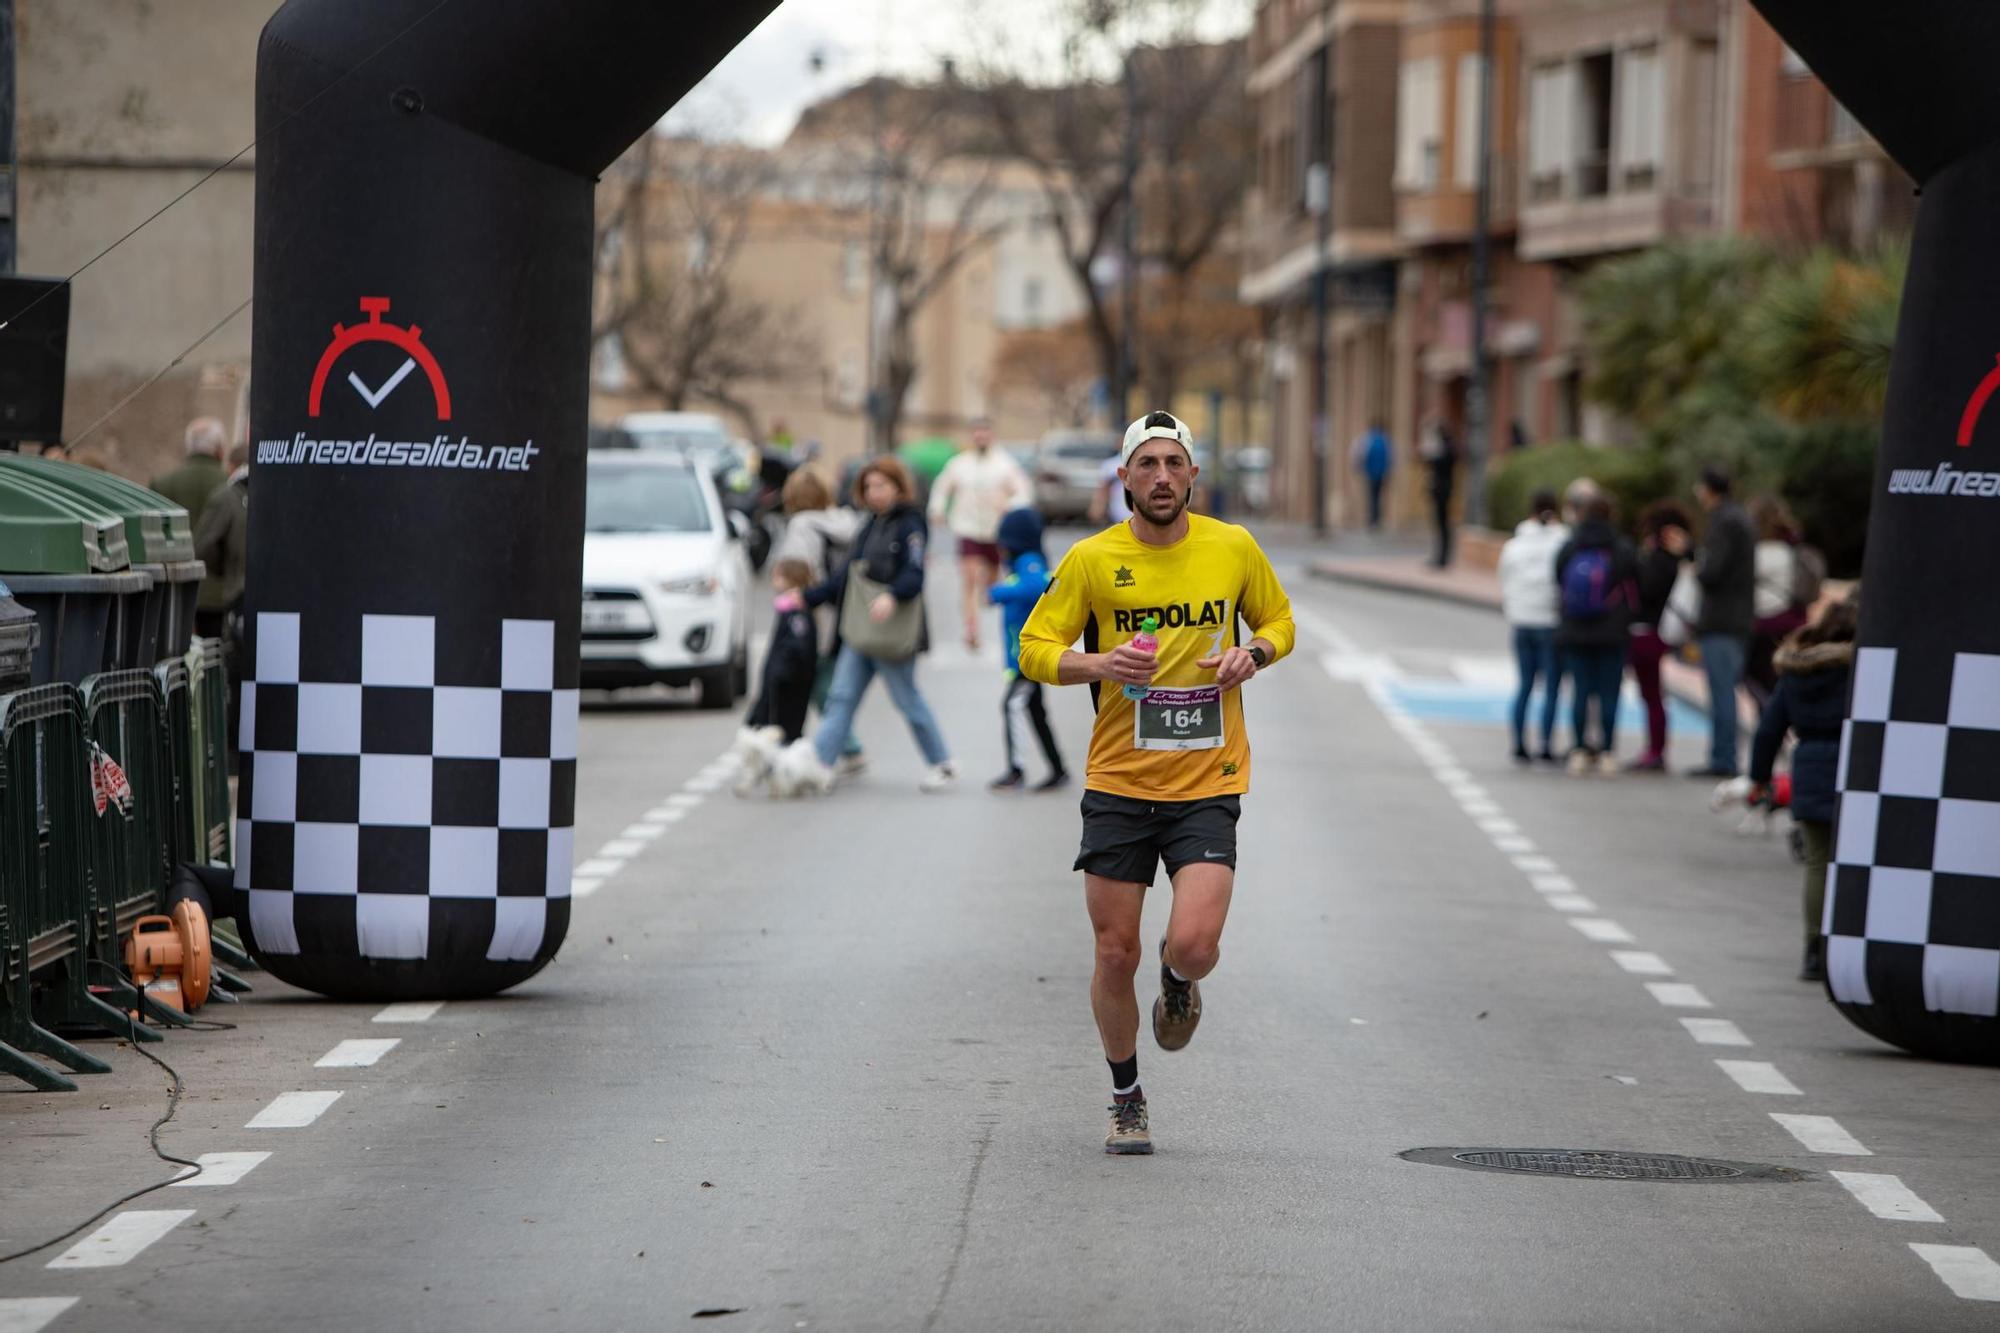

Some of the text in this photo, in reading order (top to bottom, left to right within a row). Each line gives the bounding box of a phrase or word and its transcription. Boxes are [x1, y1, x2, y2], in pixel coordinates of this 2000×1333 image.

[257, 432, 540, 471] www.lineadesalida.net
[1114, 600, 1225, 632] REDOLAT
[1153, 691, 1191, 699] Cross
[1160, 708, 1203, 728] 164
